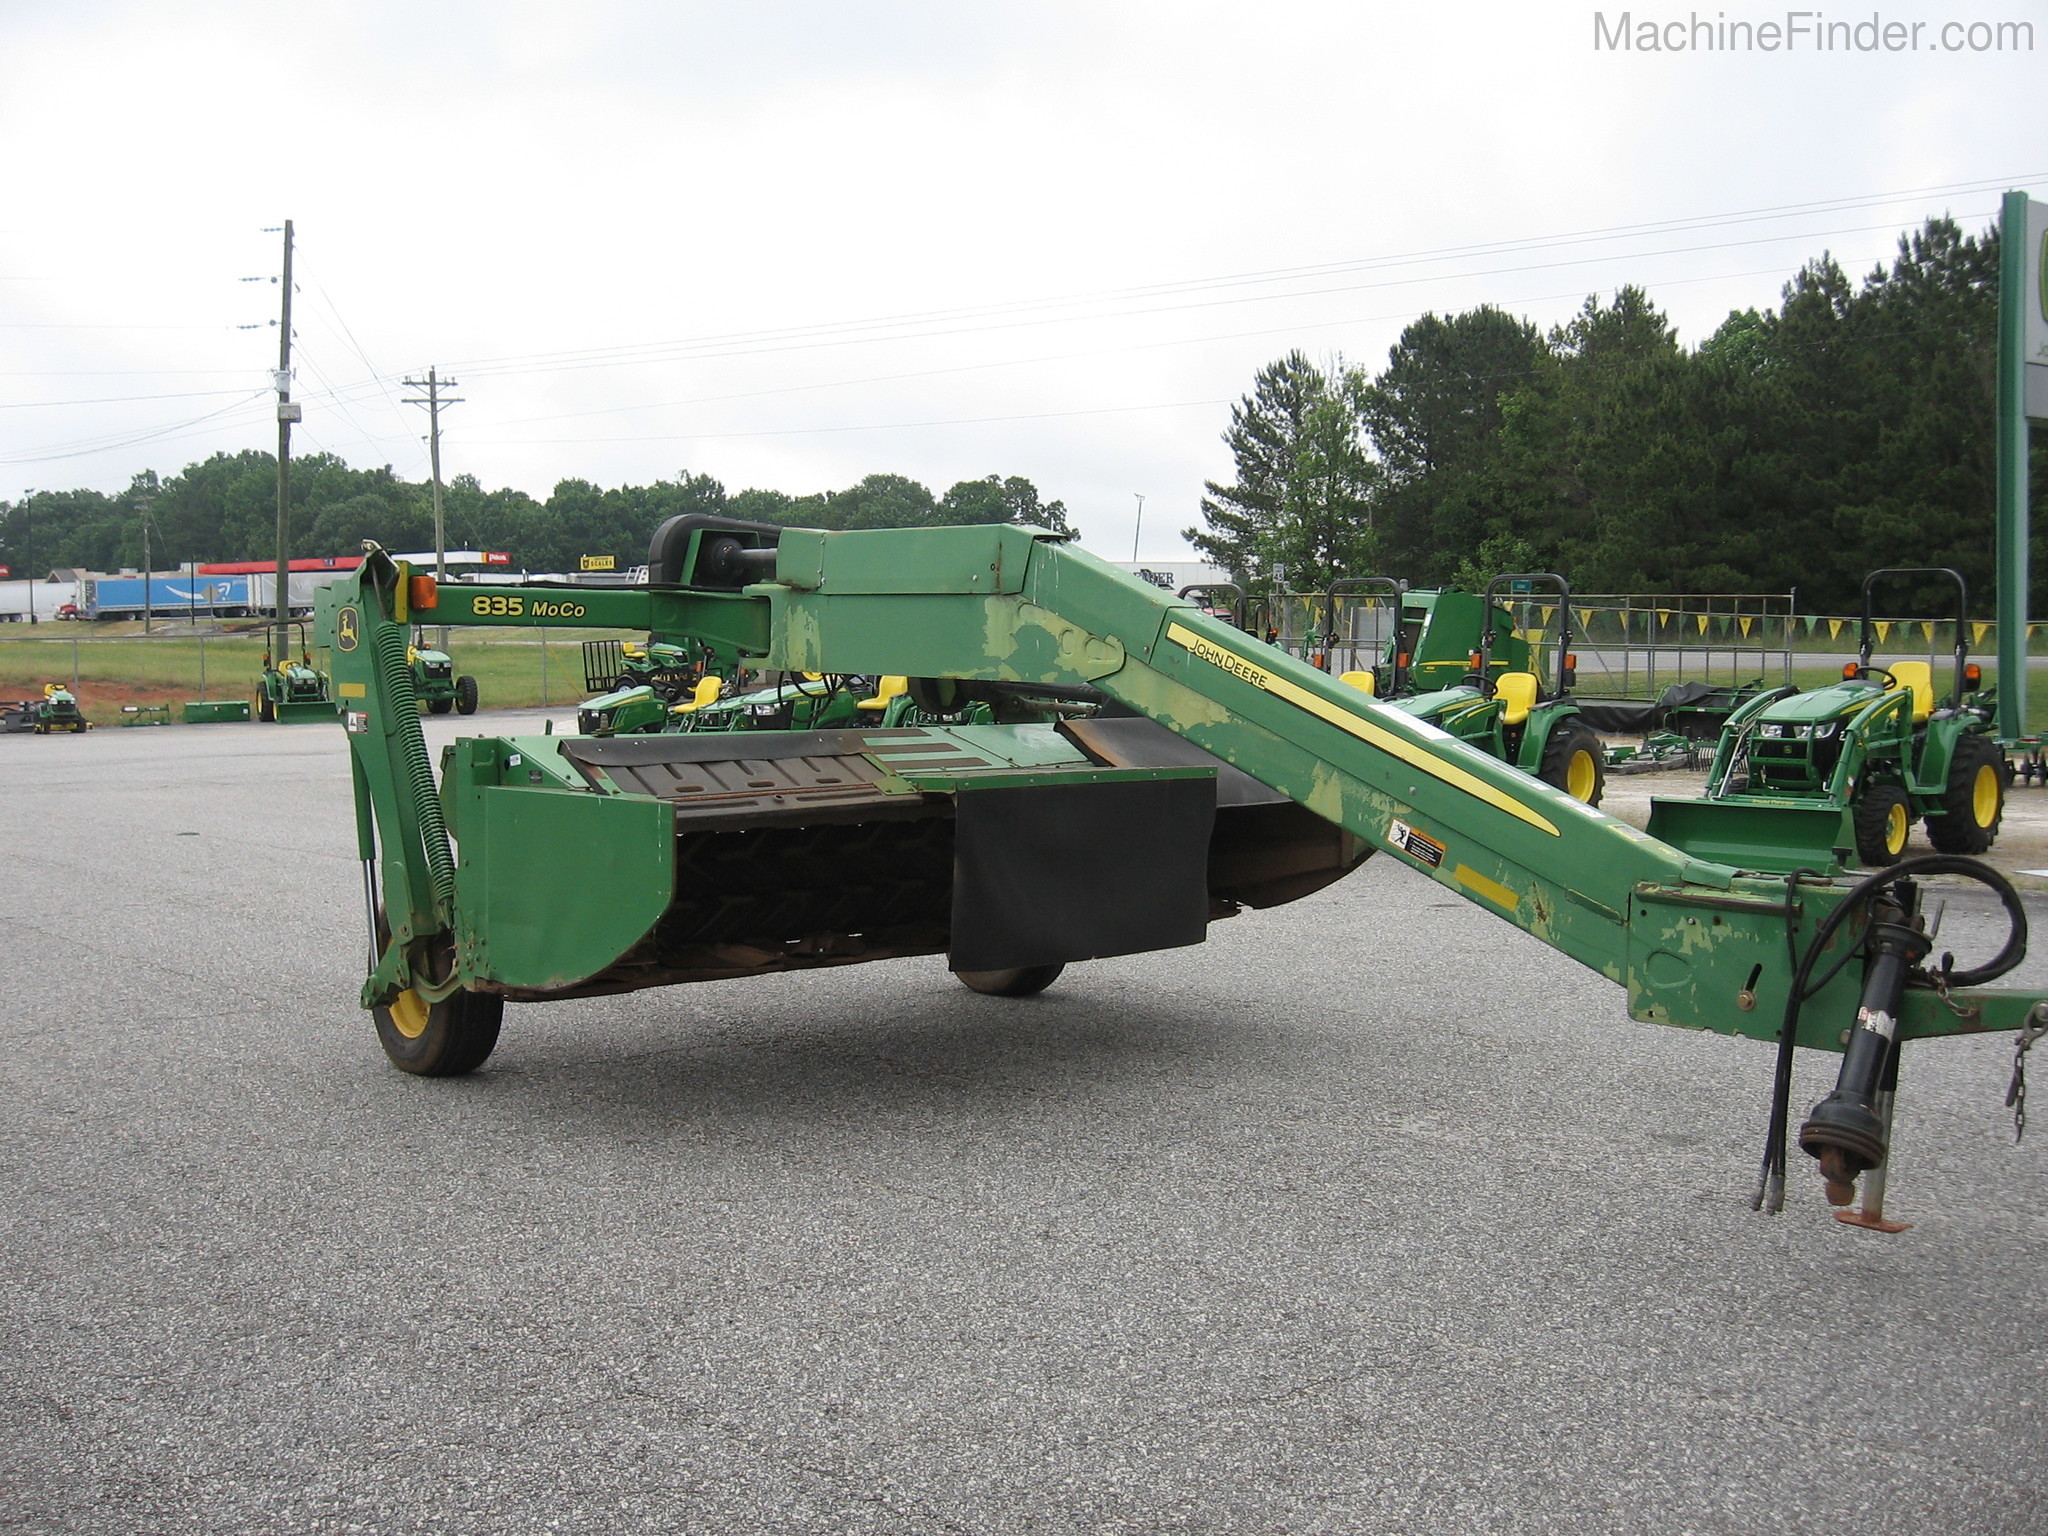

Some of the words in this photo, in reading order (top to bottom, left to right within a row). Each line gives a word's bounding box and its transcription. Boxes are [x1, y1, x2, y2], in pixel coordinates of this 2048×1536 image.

[590, 559, 613, 567] SCALES
[1273, 573, 1284, 581] 45
[472, 596, 524, 616] 835
[531, 601, 586, 617] MoCo
[1189, 639, 1225, 666] JOHN
[1224, 654, 1268, 688] DEERE
